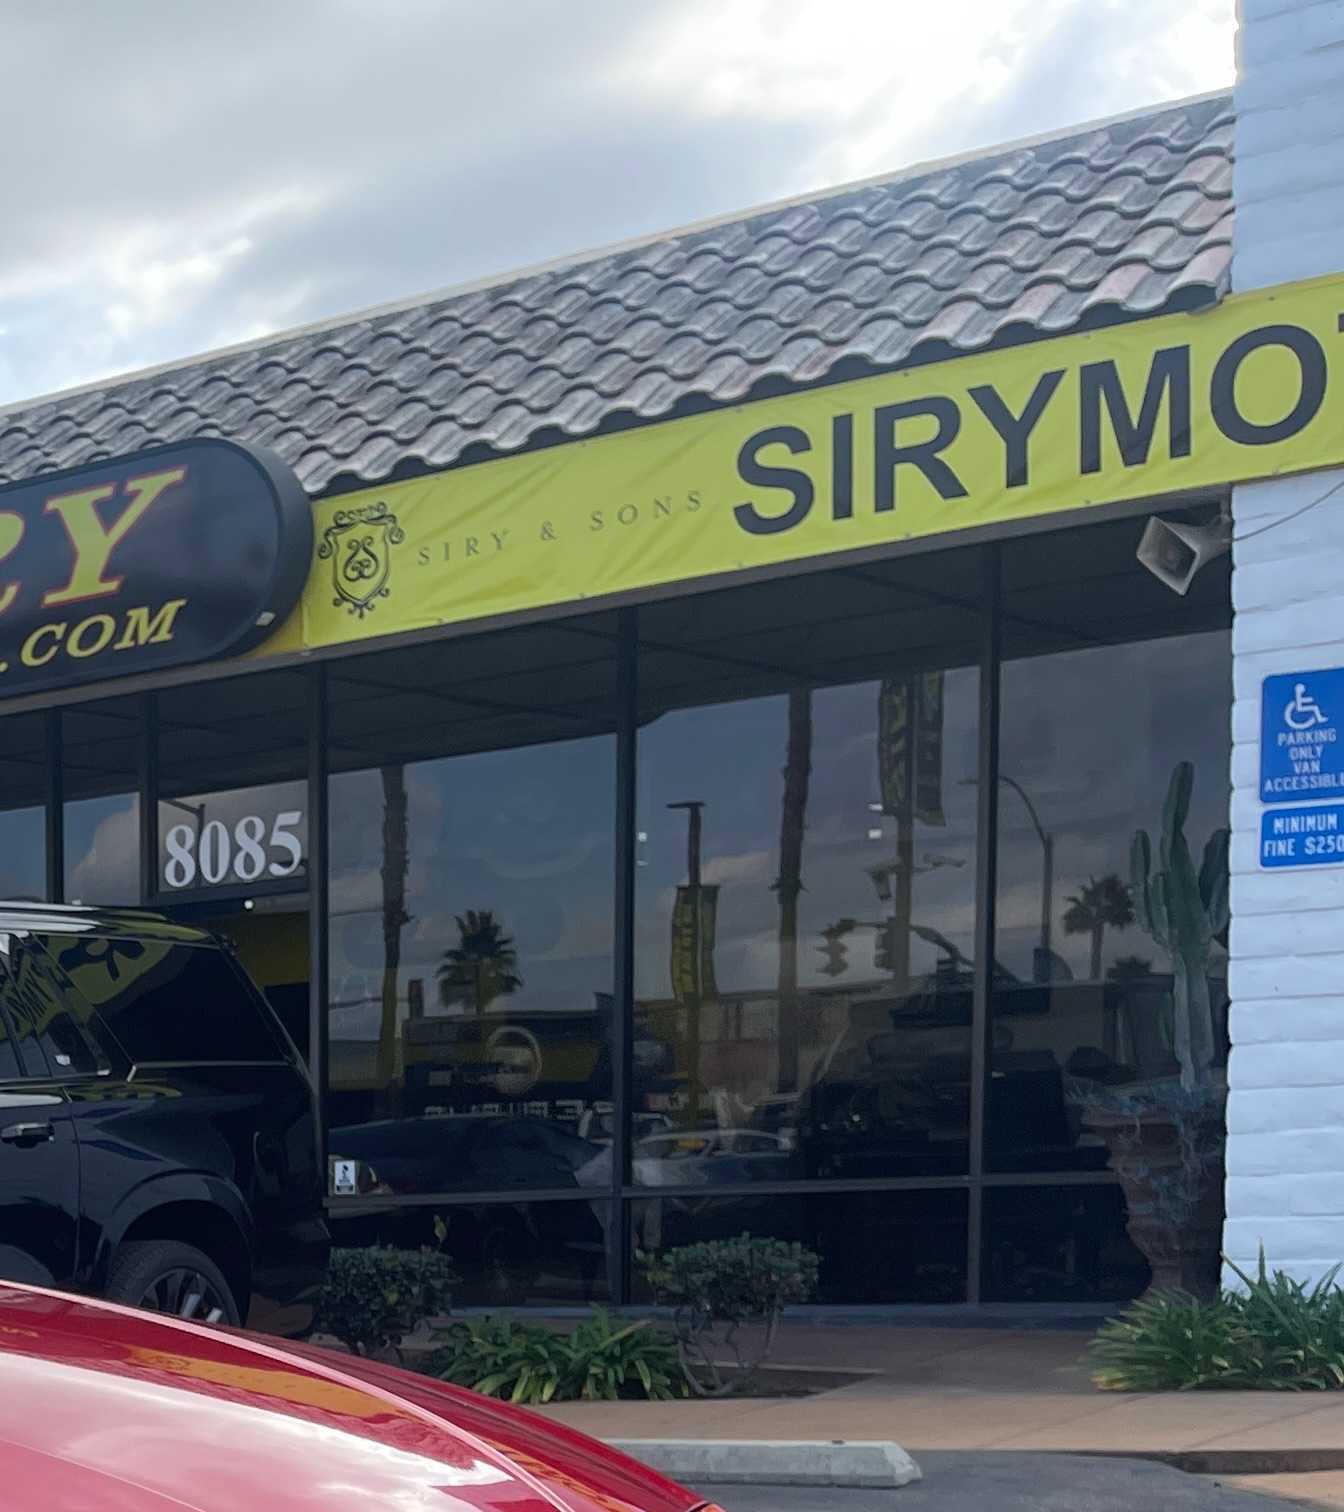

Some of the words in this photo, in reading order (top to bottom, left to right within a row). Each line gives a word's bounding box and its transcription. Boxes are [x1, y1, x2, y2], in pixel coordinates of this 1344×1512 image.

[732, 312, 1344, 536] SIRYMO
[417, 528, 510, 567] SIRY
[539, 520, 558, 542] &
[589, 490, 703, 532] SONS
[1277, 728, 1337, 747] PARKING
[1290, 744, 1323, 761] ONLY
[1293, 759, 1320, 775] VAN
[1273, 813, 1338, 835] MINIMUM
[164, 811, 302, 888] 8085
[1263, 838, 1296, 858] FINE
